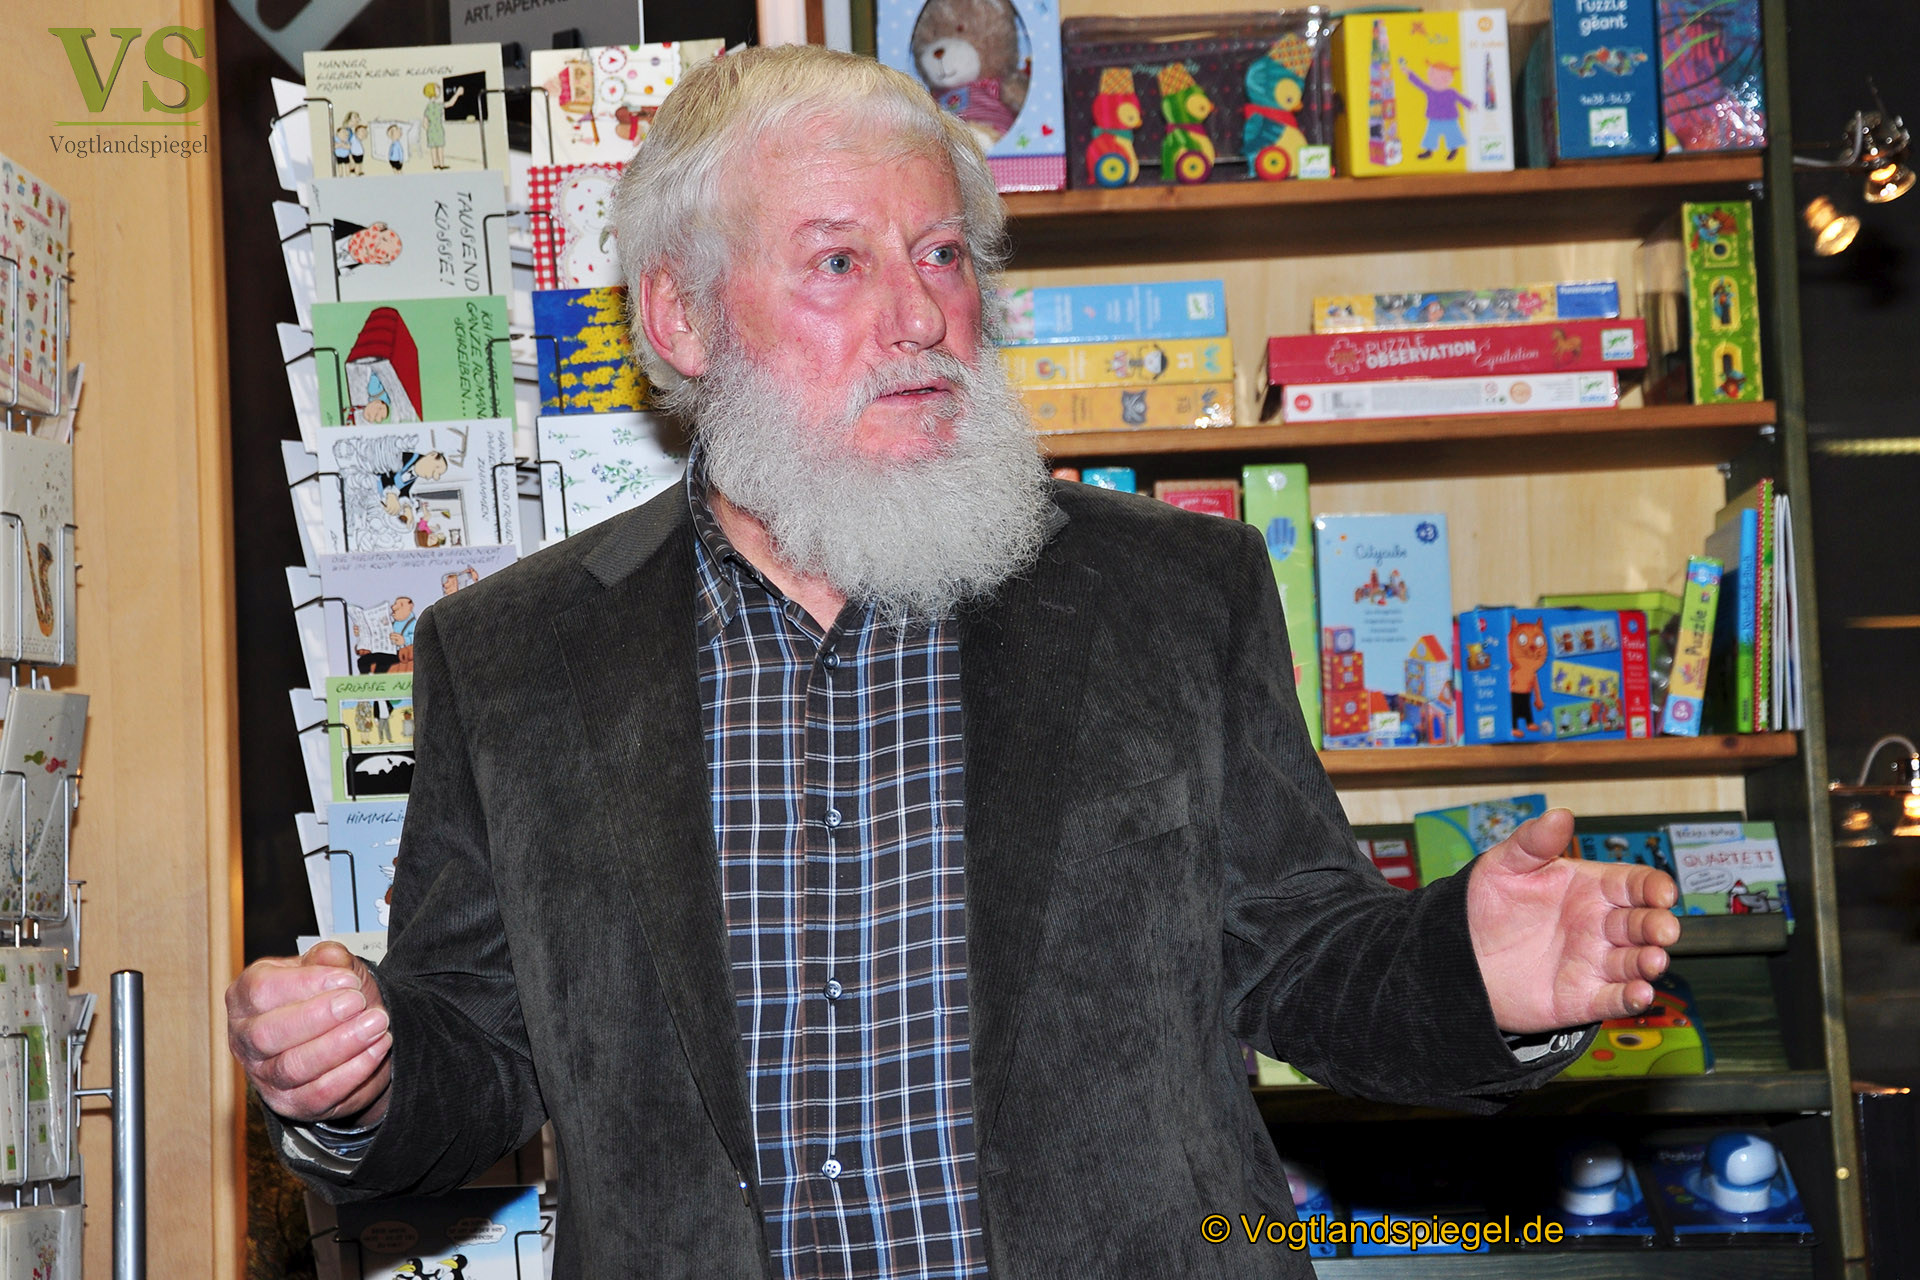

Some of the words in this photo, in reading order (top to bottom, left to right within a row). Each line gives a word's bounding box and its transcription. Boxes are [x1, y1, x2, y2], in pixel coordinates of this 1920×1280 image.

[464, 4, 493, 25] ART,
[496, 0, 540, 17] PAPER
[1580, 14, 1629, 36] géant
[457, 191, 480, 292] TAUSEND
[466, 301, 482, 357] GANZE
[1364, 334, 1426, 353] PUZZLE
[1366, 340, 1477, 369] OBSERVATION
[1472, 338, 1540, 371] Equitation
[472, 361, 487, 419] ROMAN
[1355, 544, 1408, 567] Citycube
[1685, 609, 1708, 656] Puzzle
[392, 681, 413, 691] AU
[1682, 850, 1776, 869] QUARTETT
